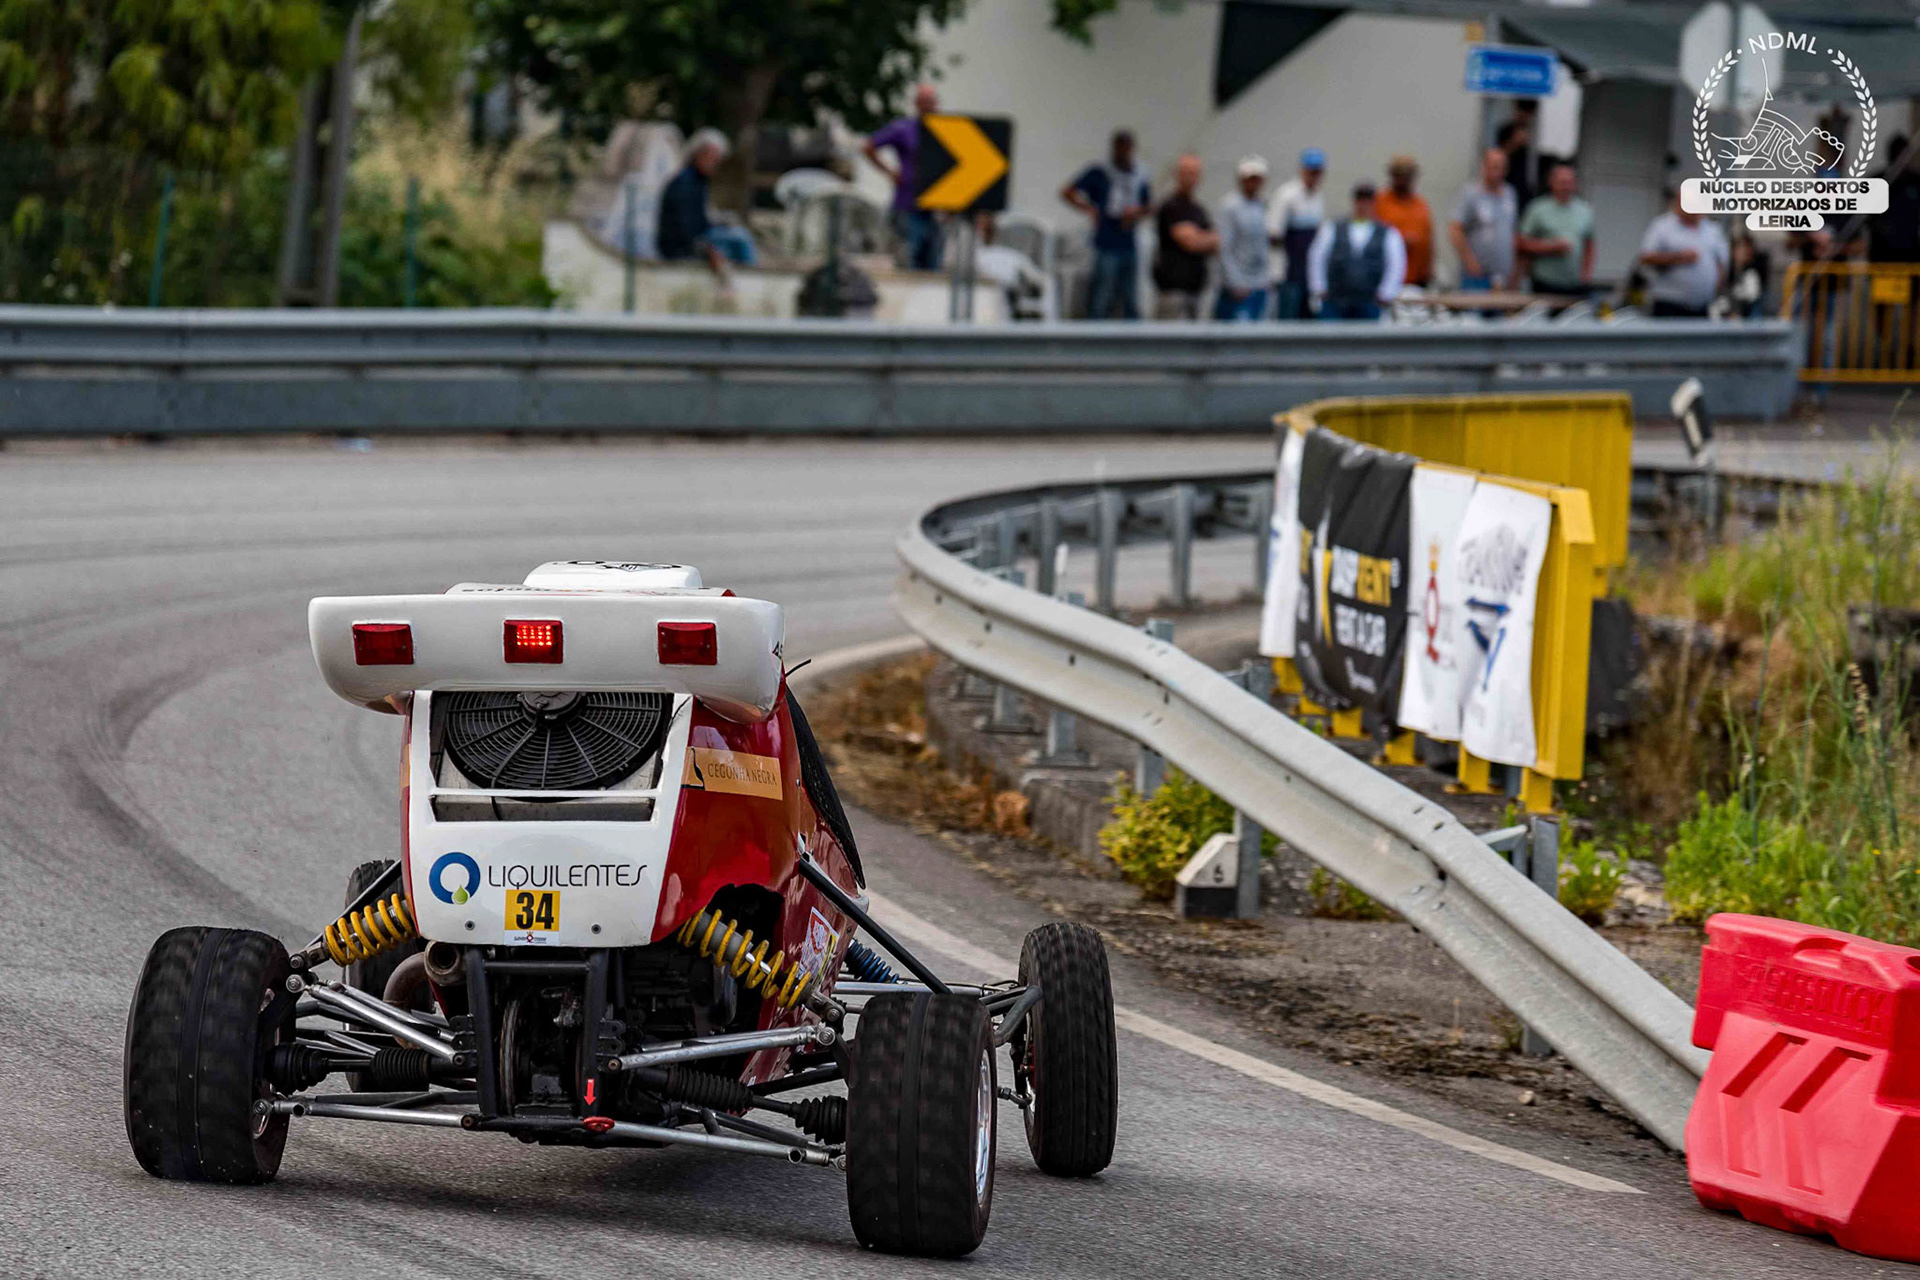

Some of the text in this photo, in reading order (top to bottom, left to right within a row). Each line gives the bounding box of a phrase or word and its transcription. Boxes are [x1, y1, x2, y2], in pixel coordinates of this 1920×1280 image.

[707, 763, 777, 786] CEGONHA NEGRA
[488, 864, 647, 889] LIQUILENTES
[515, 893, 555, 931] 34
